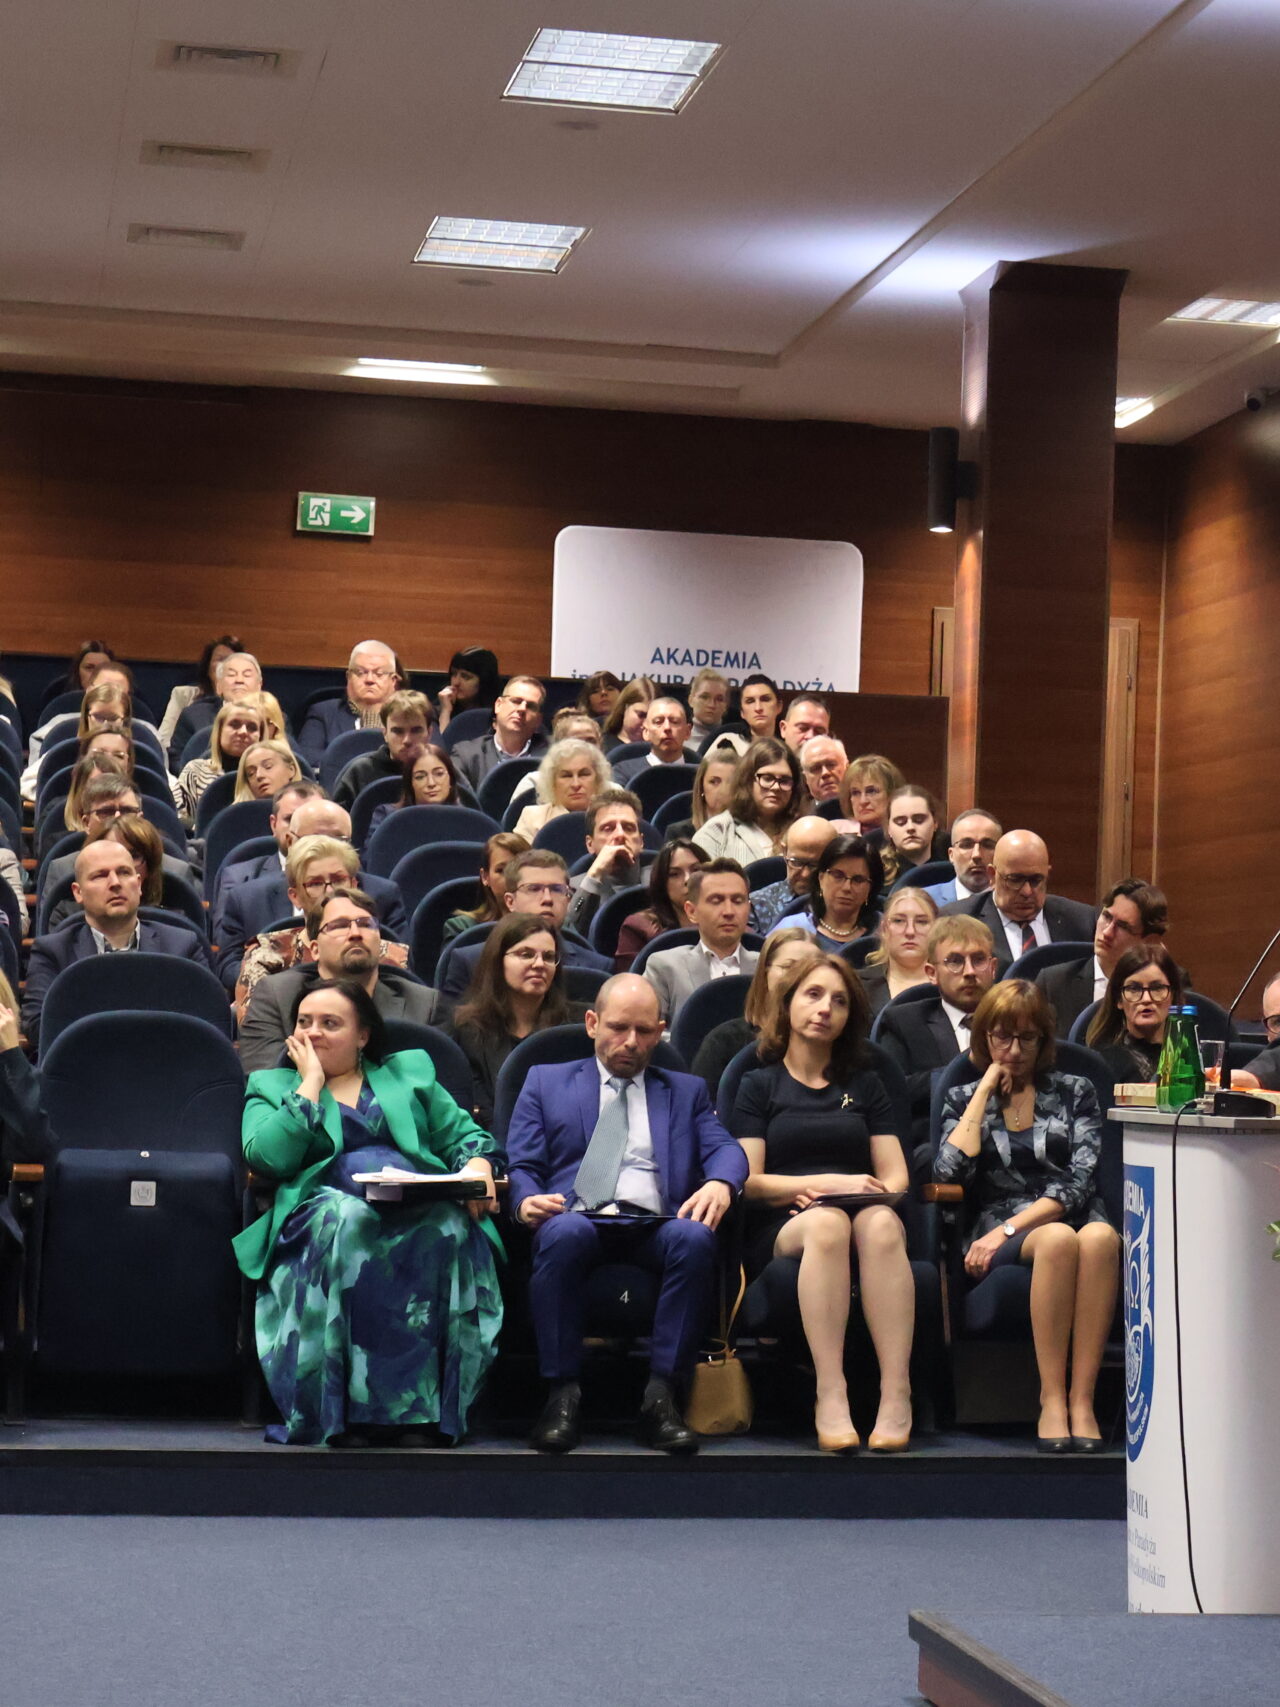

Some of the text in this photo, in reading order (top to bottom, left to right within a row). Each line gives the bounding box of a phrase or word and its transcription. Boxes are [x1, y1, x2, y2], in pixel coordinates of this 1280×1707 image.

[650, 646, 762, 670] AKADEMIA
[728, 677, 836, 692] PDYŻA
[620, 1290, 630, 1304] 4
